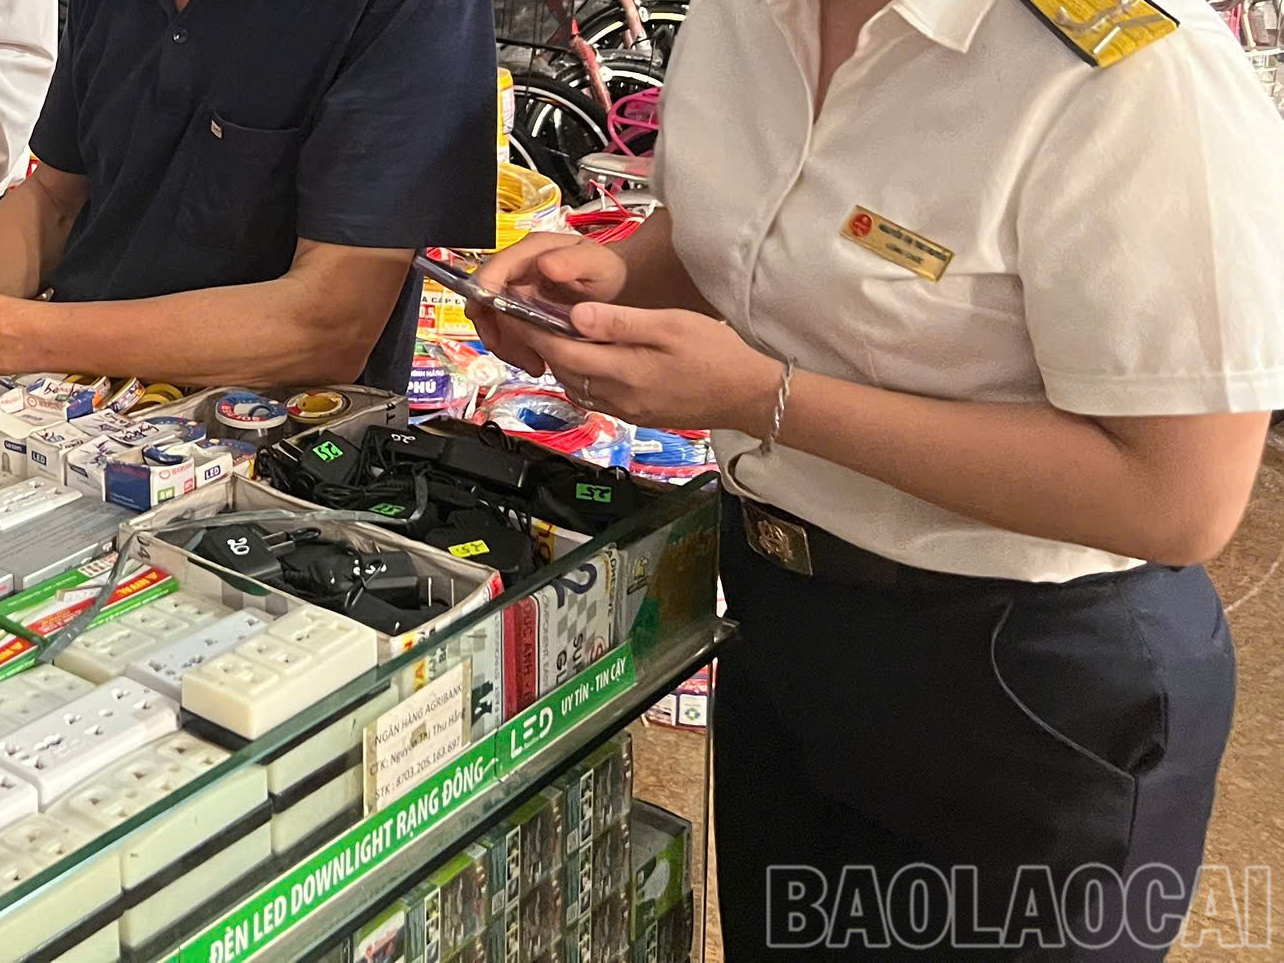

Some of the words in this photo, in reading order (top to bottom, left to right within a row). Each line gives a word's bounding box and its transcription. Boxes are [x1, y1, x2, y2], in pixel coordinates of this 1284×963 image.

[407, 380, 437, 395] PHÚ
[31, 450, 47, 465] LED
[204, 465, 221, 481] LED
[561, 695, 573, 716] UY
[574, 682, 590, 705] TÍN
[595, 669, 610, 692] TIN
[432, 722, 447, 737] Thu
[209, 921, 249, 963] ĐÈN
[252, 895, 288, 935] LED
[290, 818, 395, 916] DOWNLIGHT
[395, 788, 440, 838] RẠNG
[442, 755, 484, 807] ĐÔNG
